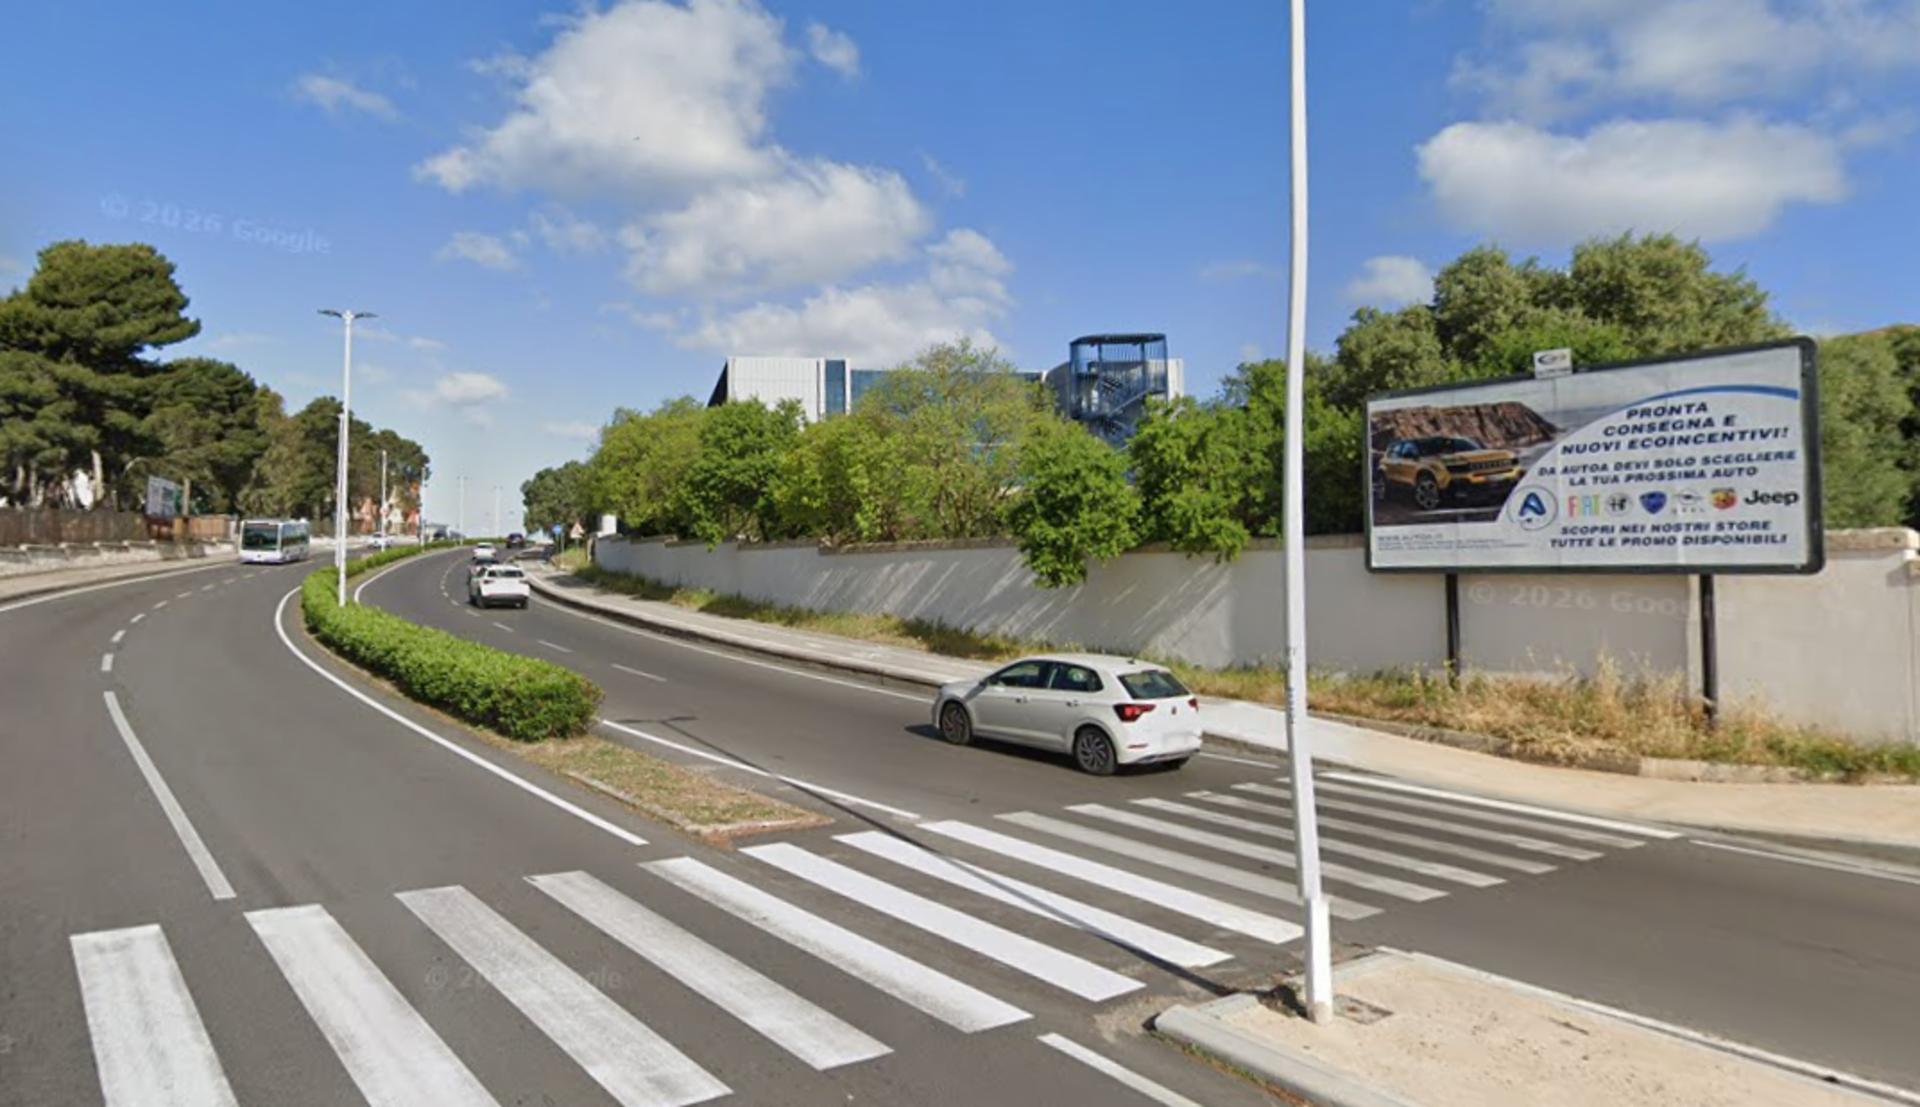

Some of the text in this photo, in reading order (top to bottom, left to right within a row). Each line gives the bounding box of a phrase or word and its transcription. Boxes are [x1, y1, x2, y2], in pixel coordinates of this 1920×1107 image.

[1627, 402, 1708, 420] PRONTA
[1603, 415, 1737, 437] CONSEGNA E
[1561, 427, 1789, 455] NUOVI ECOINCENTIVI!
[1538, 450, 1797, 477] DA AUTOA DEVI SOLO SCEGLIERE
[1569, 466, 1758, 487] LA TUA PROSSIMA AUTO
[1745, 490, 1799, 506] Jeep
[1560, 520, 1771, 536] SCOPRI NEI NOSTRI STORE
[1551, 534, 1788, 548] TUTTE LE PROMO DISPONIBILI
